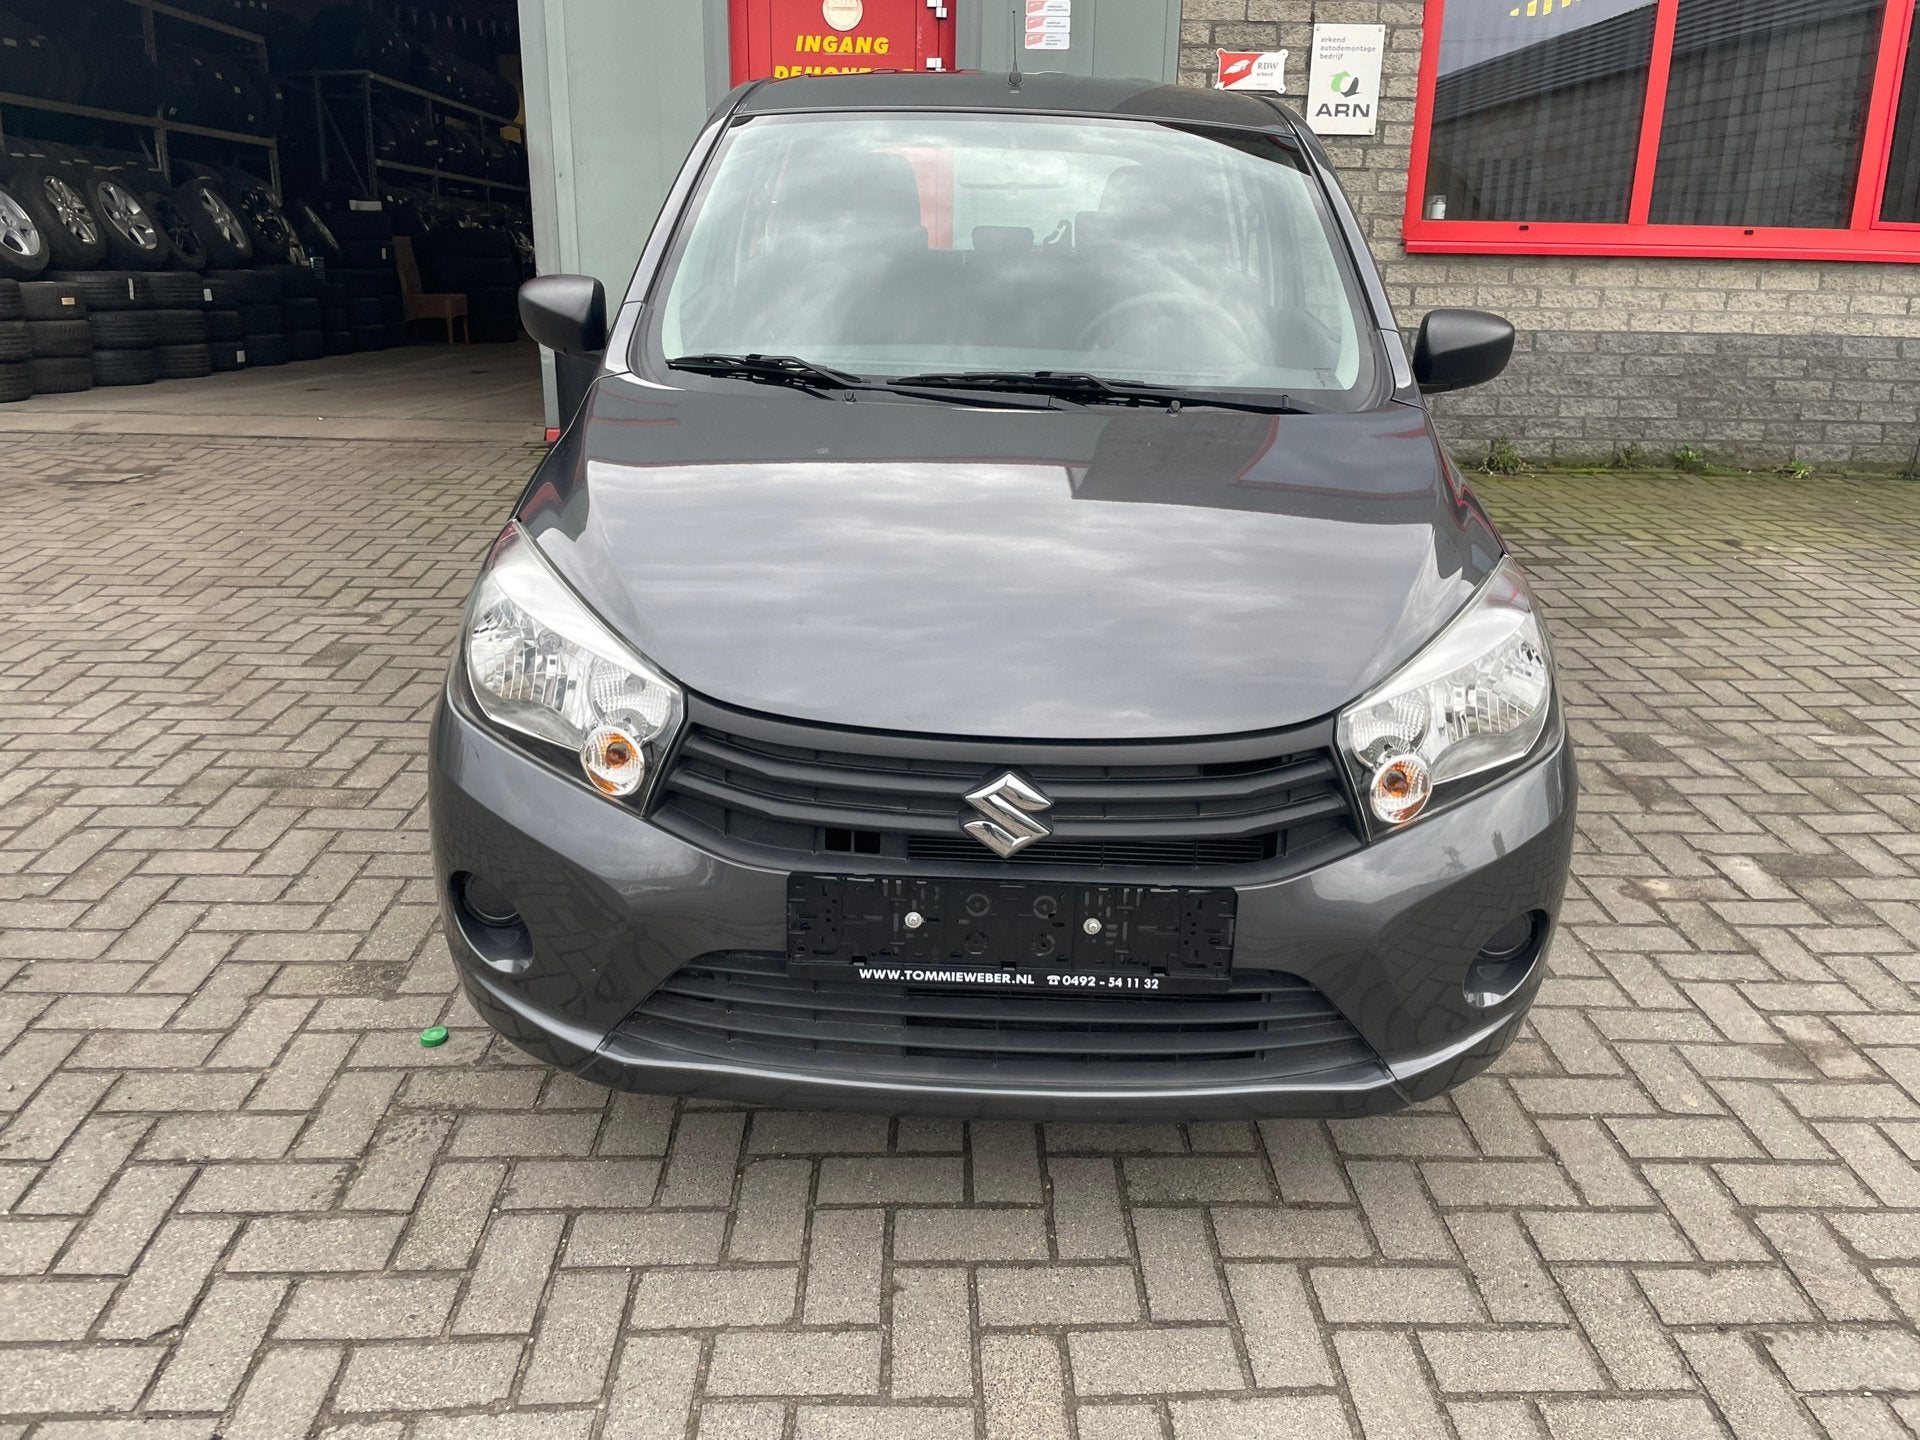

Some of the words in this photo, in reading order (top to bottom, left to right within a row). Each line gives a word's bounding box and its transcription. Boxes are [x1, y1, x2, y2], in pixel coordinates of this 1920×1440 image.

[795, 35, 890, 54] INGANG
[1319, 45, 1376, 53] autodemontage
[1257, 62, 1279, 70] RDW
[1315, 103, 1370, 117] ARN
[858, 968, 1035, 985] WWW.TOMMIEWEBER.NL
[1062, 975, 1096, 987] 0492
[1107, 976, 1123, 988] 54
[1127, 977, 1139, 988] 11
[1143, 978, 1159, 989] 32
